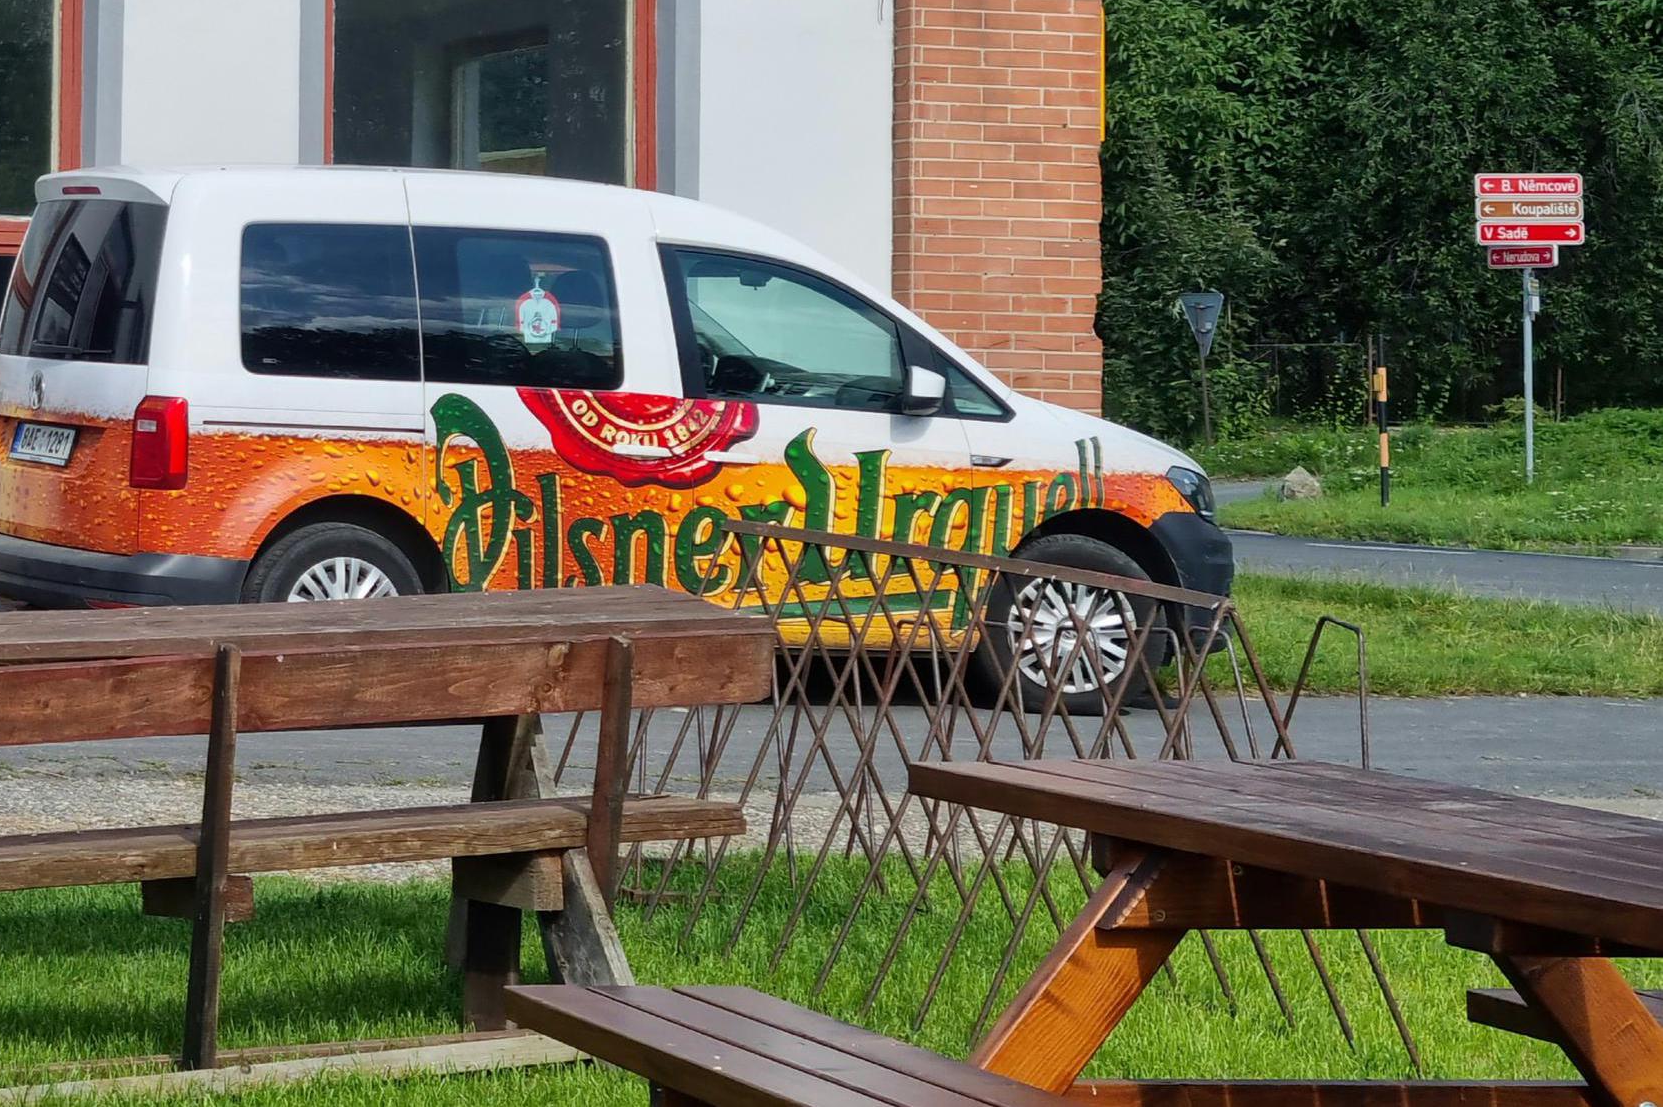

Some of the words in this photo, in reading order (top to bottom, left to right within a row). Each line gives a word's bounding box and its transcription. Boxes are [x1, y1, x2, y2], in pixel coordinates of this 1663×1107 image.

[1501, 180, 1514, 192] B.
[1518, 179, 1575, 192] Němcové
[1512, 202, 1576, 218] Koupaliště
[1483, 227, 1493, 239] V
[1497, 226, 1528, 239] Sadě
[571, 399, 599, 427] OD
[600, 421, 658, 447] ROKU
[663, 408, 709, 447] 1842
[46, 429, 71, 456] 1281
[430, 392, 793, 599] Pilsner
[783, 427, 1105, 641] Urquell
